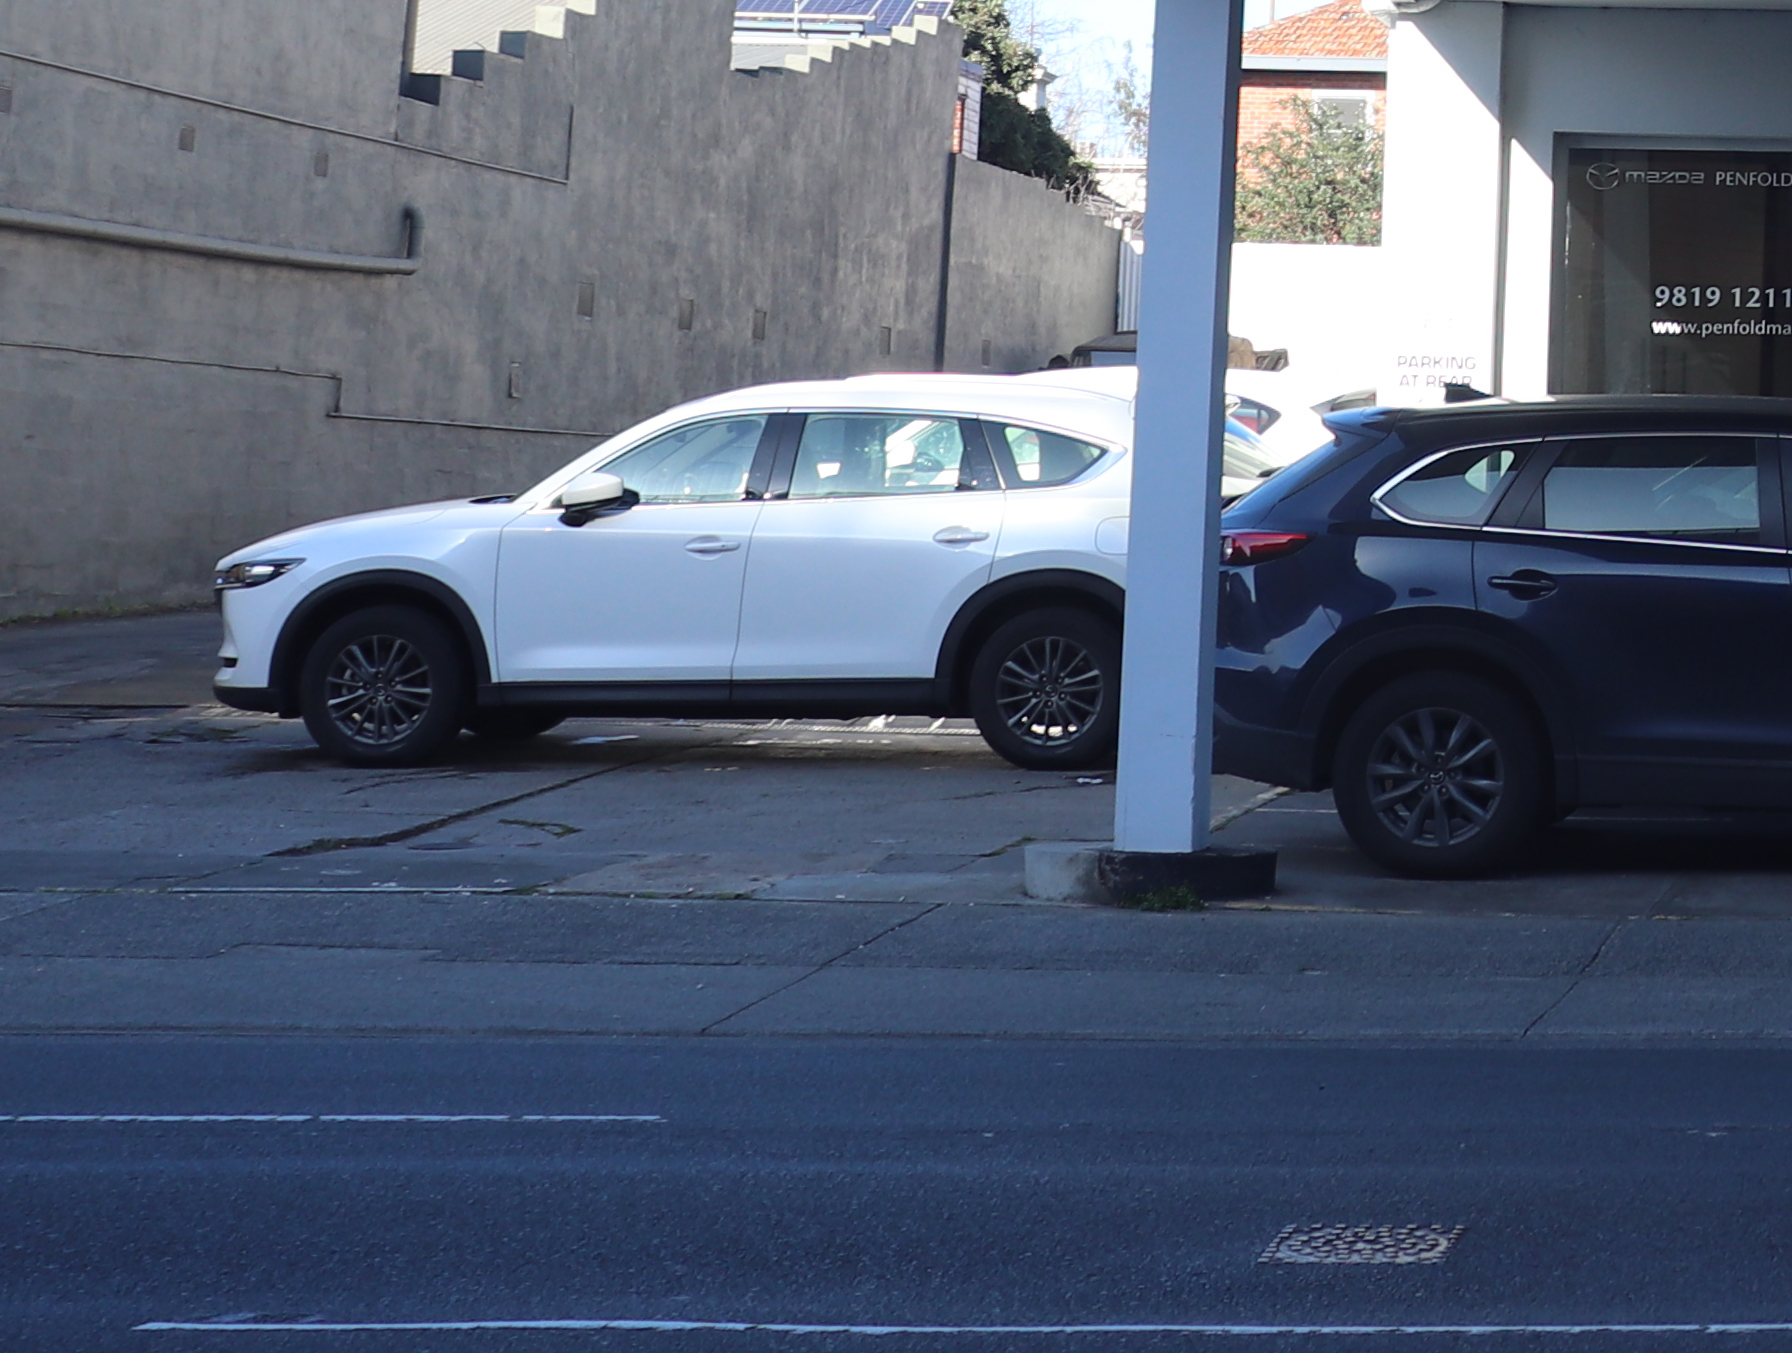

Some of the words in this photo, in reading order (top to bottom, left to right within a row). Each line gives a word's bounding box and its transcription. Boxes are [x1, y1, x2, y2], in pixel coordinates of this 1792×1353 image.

[1715, 172, 1792, 187] PENFOLD
[1654, 285, 1721, 308] 9819
[1731, 287, 1792, 308] 1211
[1397, 355, 1477, 370] PARKING
[1399, 374, 1419, 388] AT
